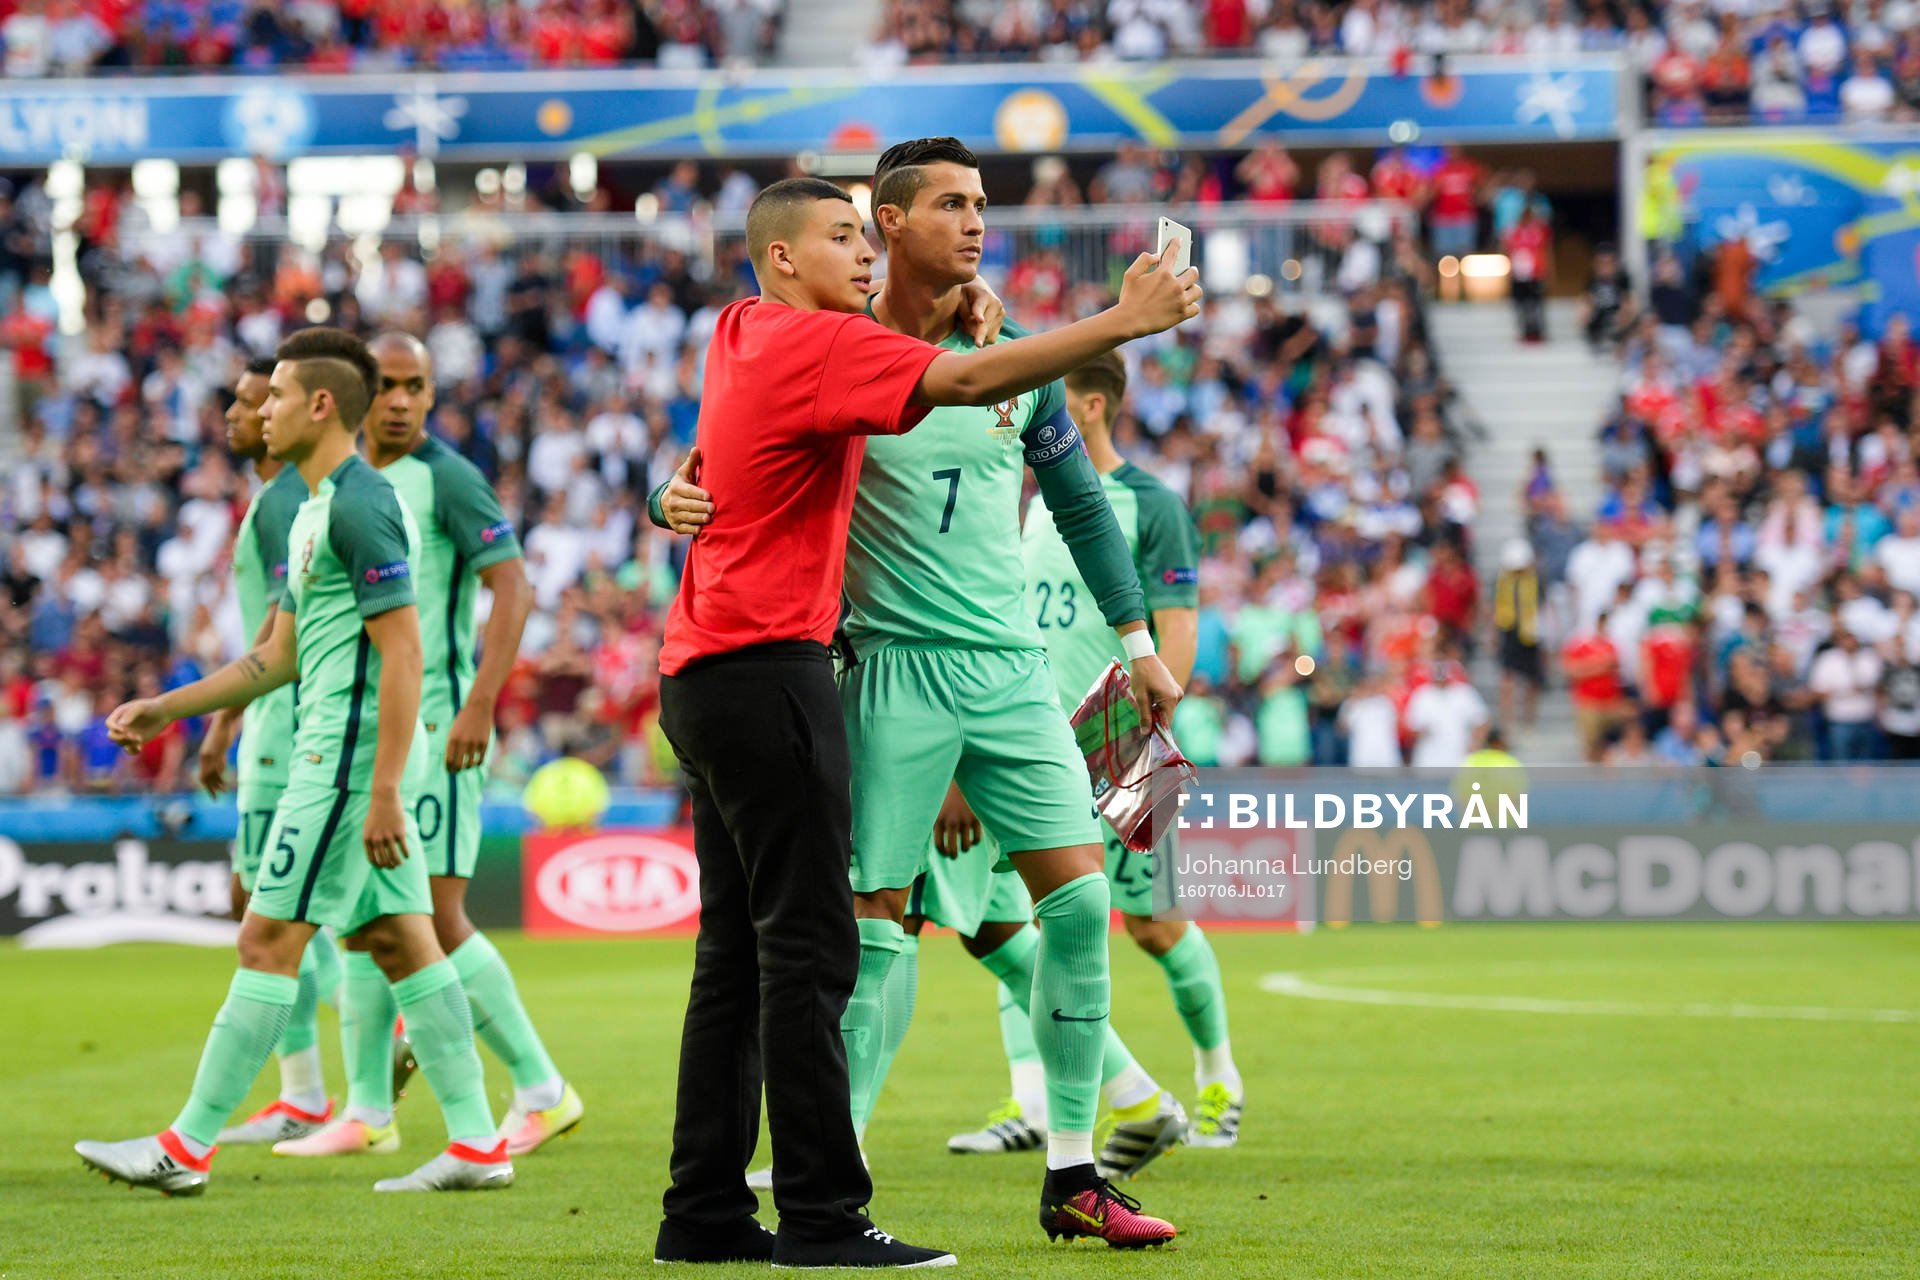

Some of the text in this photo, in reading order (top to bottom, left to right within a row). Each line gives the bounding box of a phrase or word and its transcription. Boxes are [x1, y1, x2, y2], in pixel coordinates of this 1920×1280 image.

[1036, 450, 1050, 459] TO
[932, 468, 961, 533] 7
[1036, 581, 1076, 629] 23
[270, 826, 300, 878] 5
[1452, 834, 1920, 918] McDona
[565, 858, 690, 909] KIA
